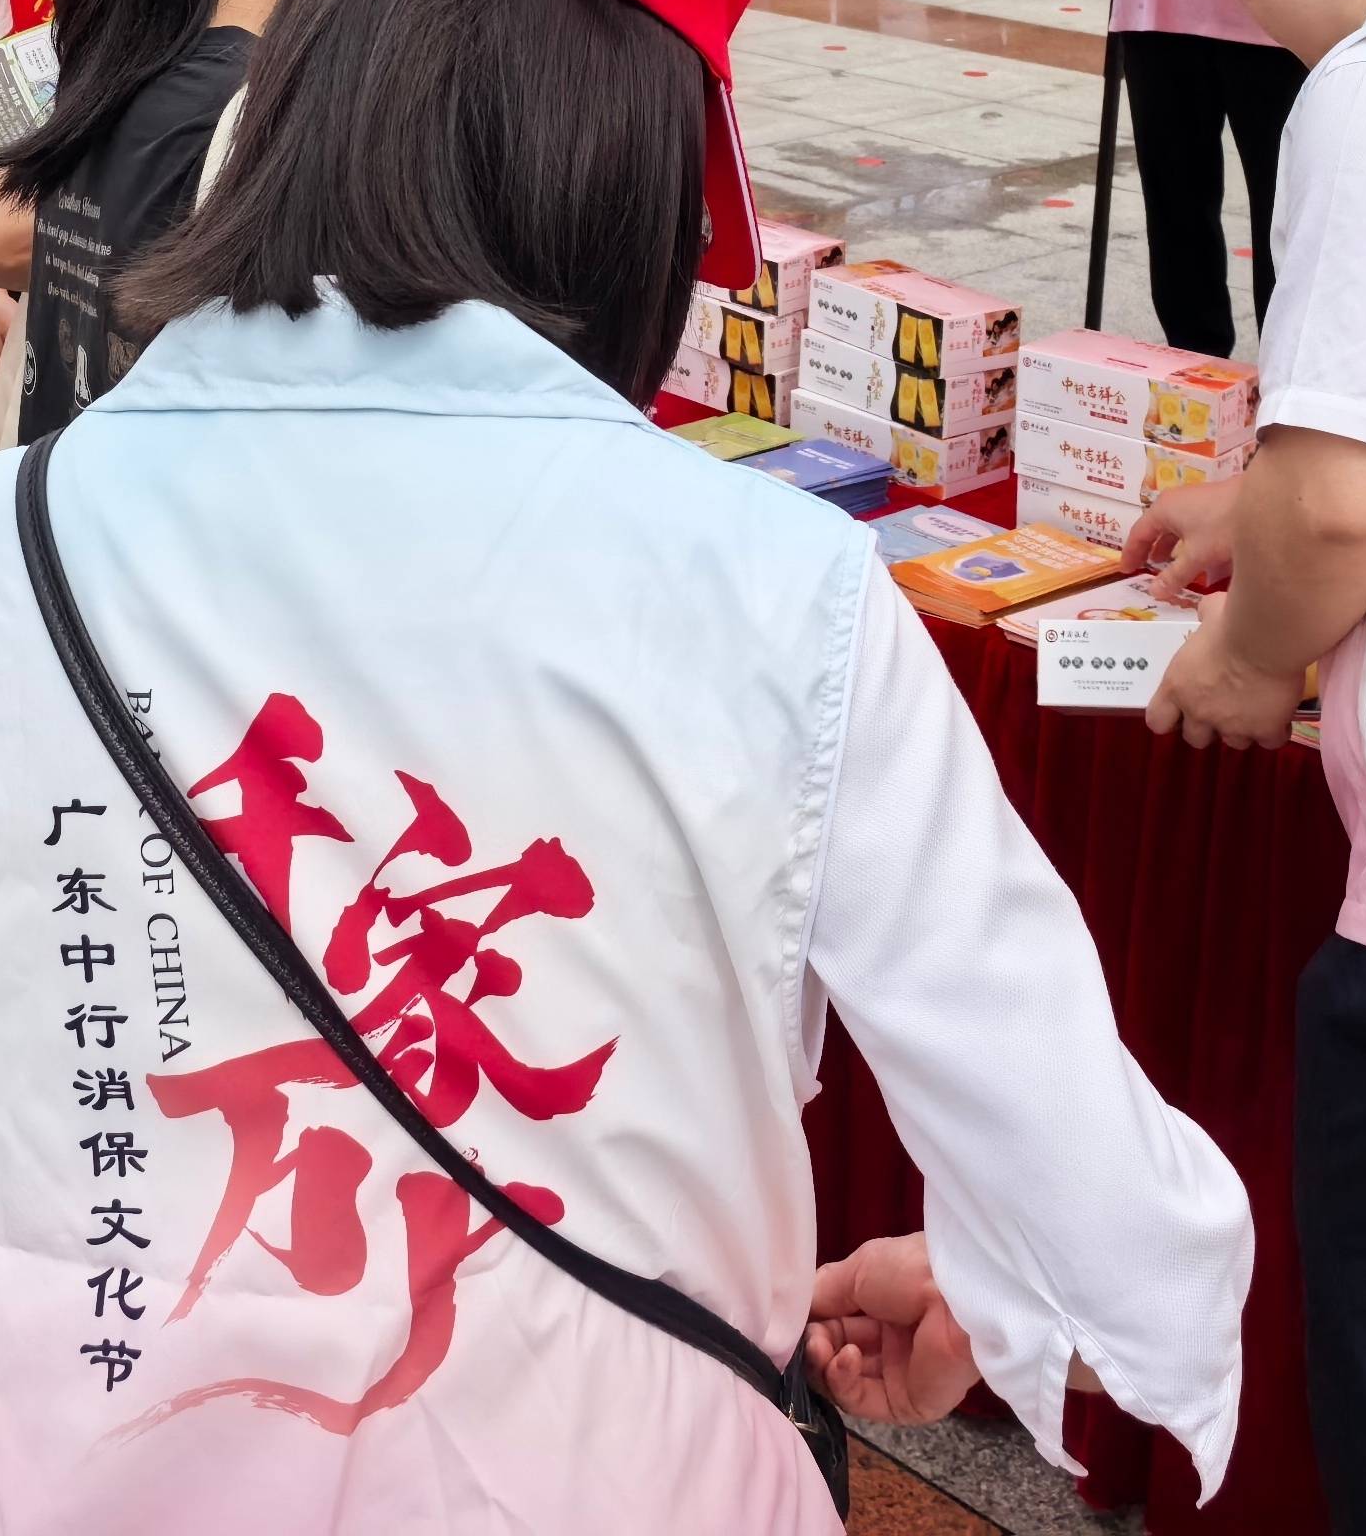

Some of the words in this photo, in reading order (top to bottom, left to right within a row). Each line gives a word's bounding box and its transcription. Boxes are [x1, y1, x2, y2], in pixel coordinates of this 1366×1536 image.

[140, 832, 175, 896] OF
[147, 912, 192, 1063] CHINA
[44, 799, 150, 1393] 广东中行消保文化节
